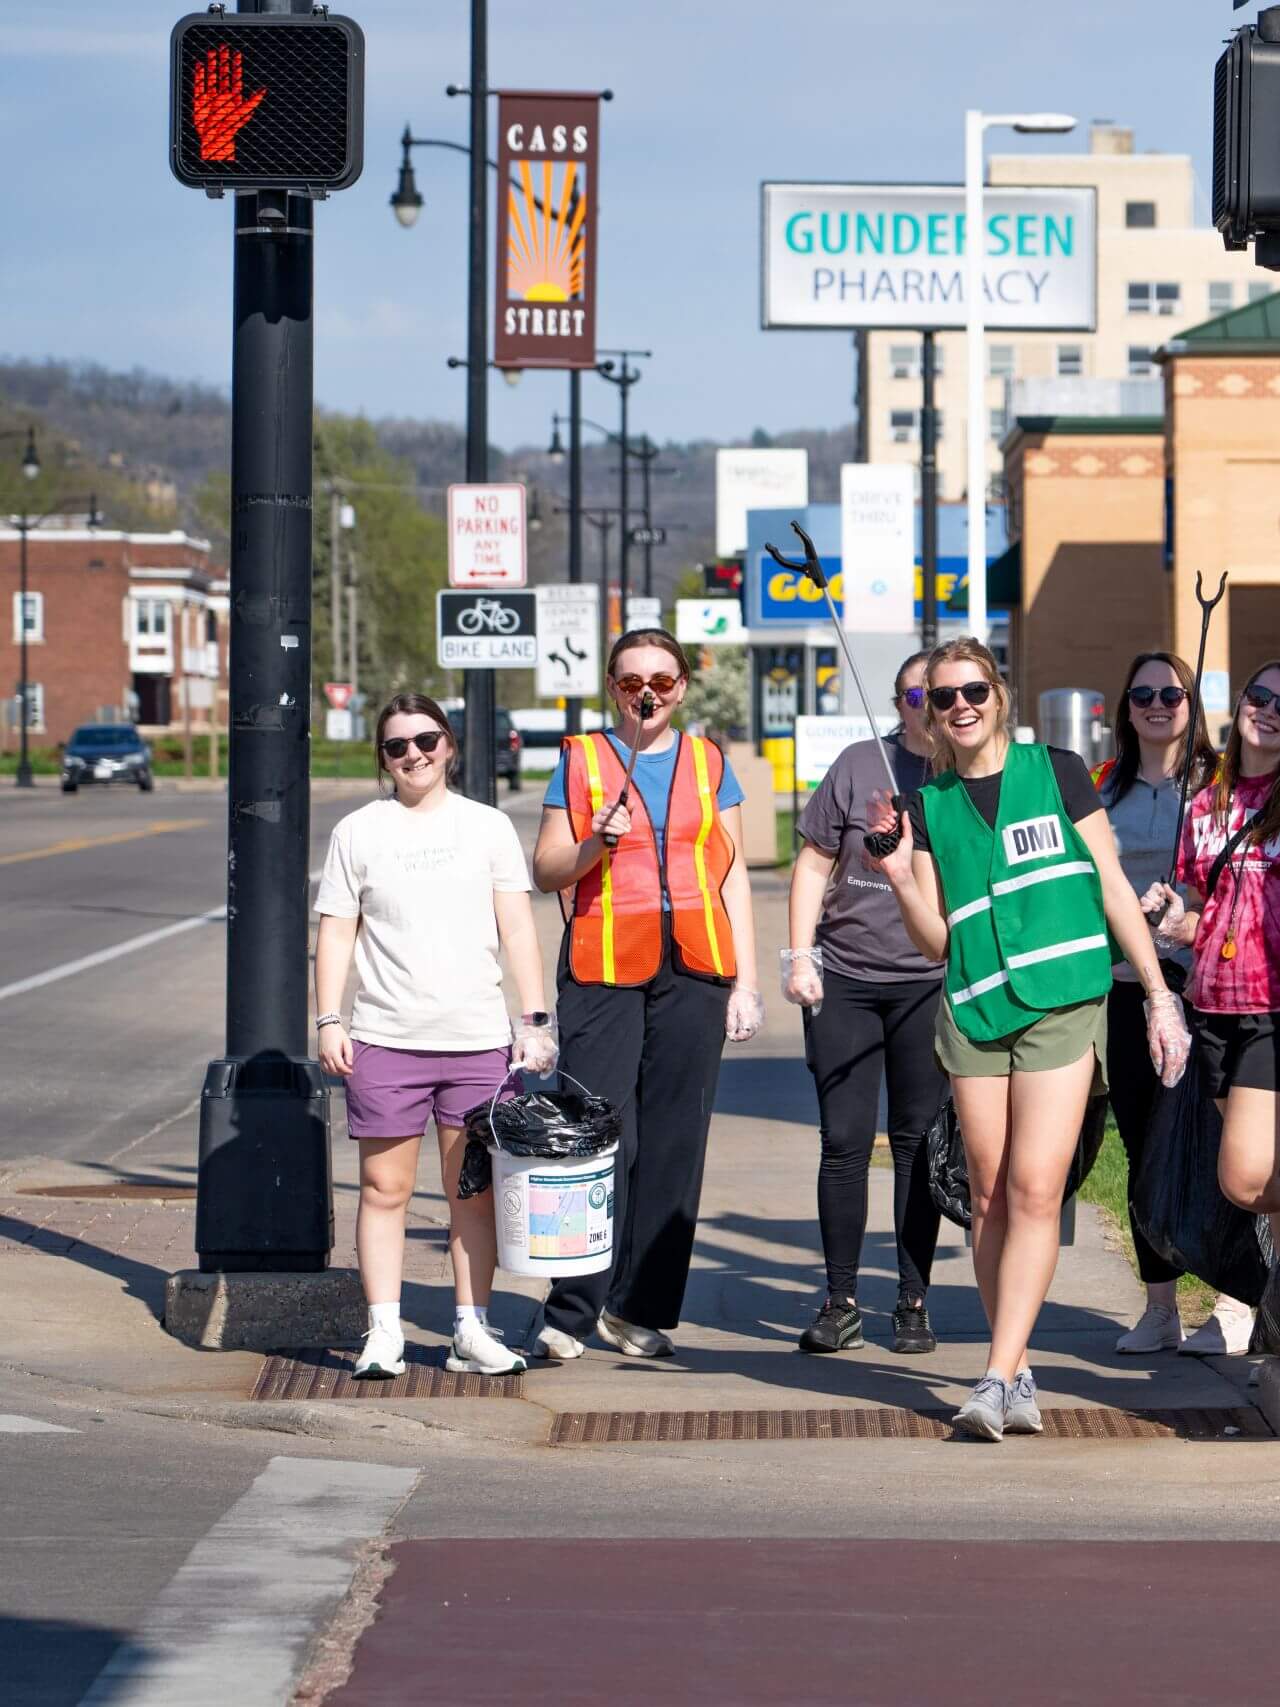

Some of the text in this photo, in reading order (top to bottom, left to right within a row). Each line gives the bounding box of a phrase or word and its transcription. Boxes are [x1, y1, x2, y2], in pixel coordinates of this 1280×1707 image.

[507, 124, 587, 153] CASS
[505, 307, 585, 337] STREET
[474, 496, 499, 512] NO
[457, 518, 519, 535] PARKING
[474, 540, 501, 551] ANY
[474, 553, 501, 565] TIME
[445, 642, 534, 658] BIKE LANE
[1012, 821, 1059, 856] DMI
[589, 1231, 603, 1243] ZONE
